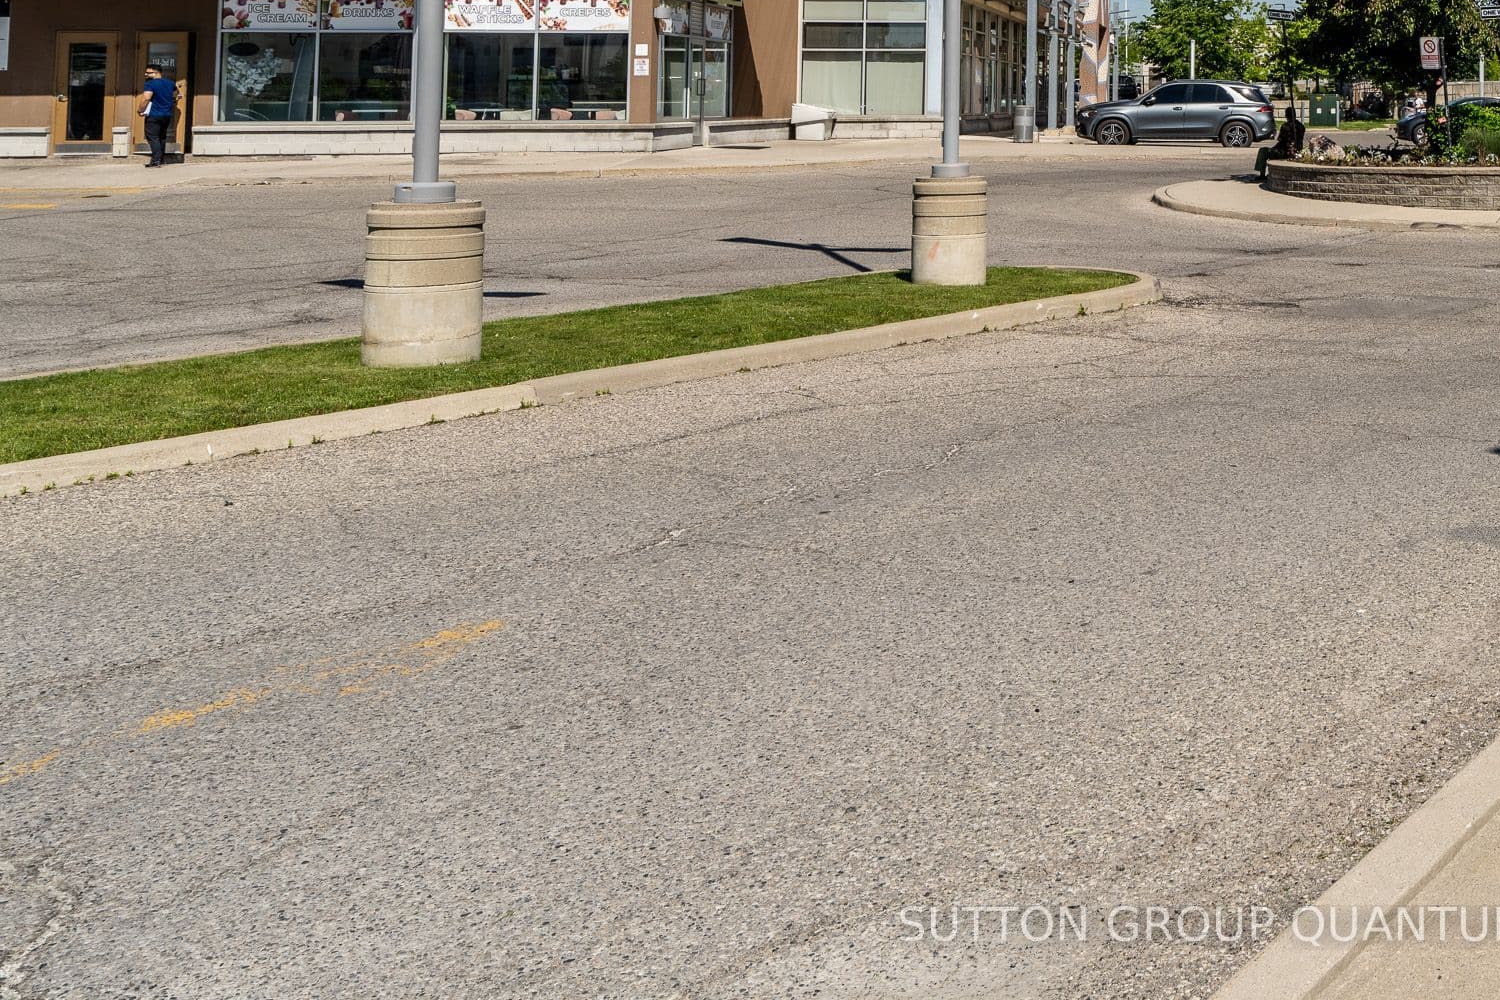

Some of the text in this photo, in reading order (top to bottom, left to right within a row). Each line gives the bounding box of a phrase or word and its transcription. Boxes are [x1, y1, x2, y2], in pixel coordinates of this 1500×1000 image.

[247, 4, 271, 14] ICE
[342, 7, 395, 18] DRINKS
[458, 4, 512, 15] WAFFLE
[560, 7, 611, 18] CREPES
[257, 14, 308, 24] CREAM
[476, 14, 525, 24] STICKS
